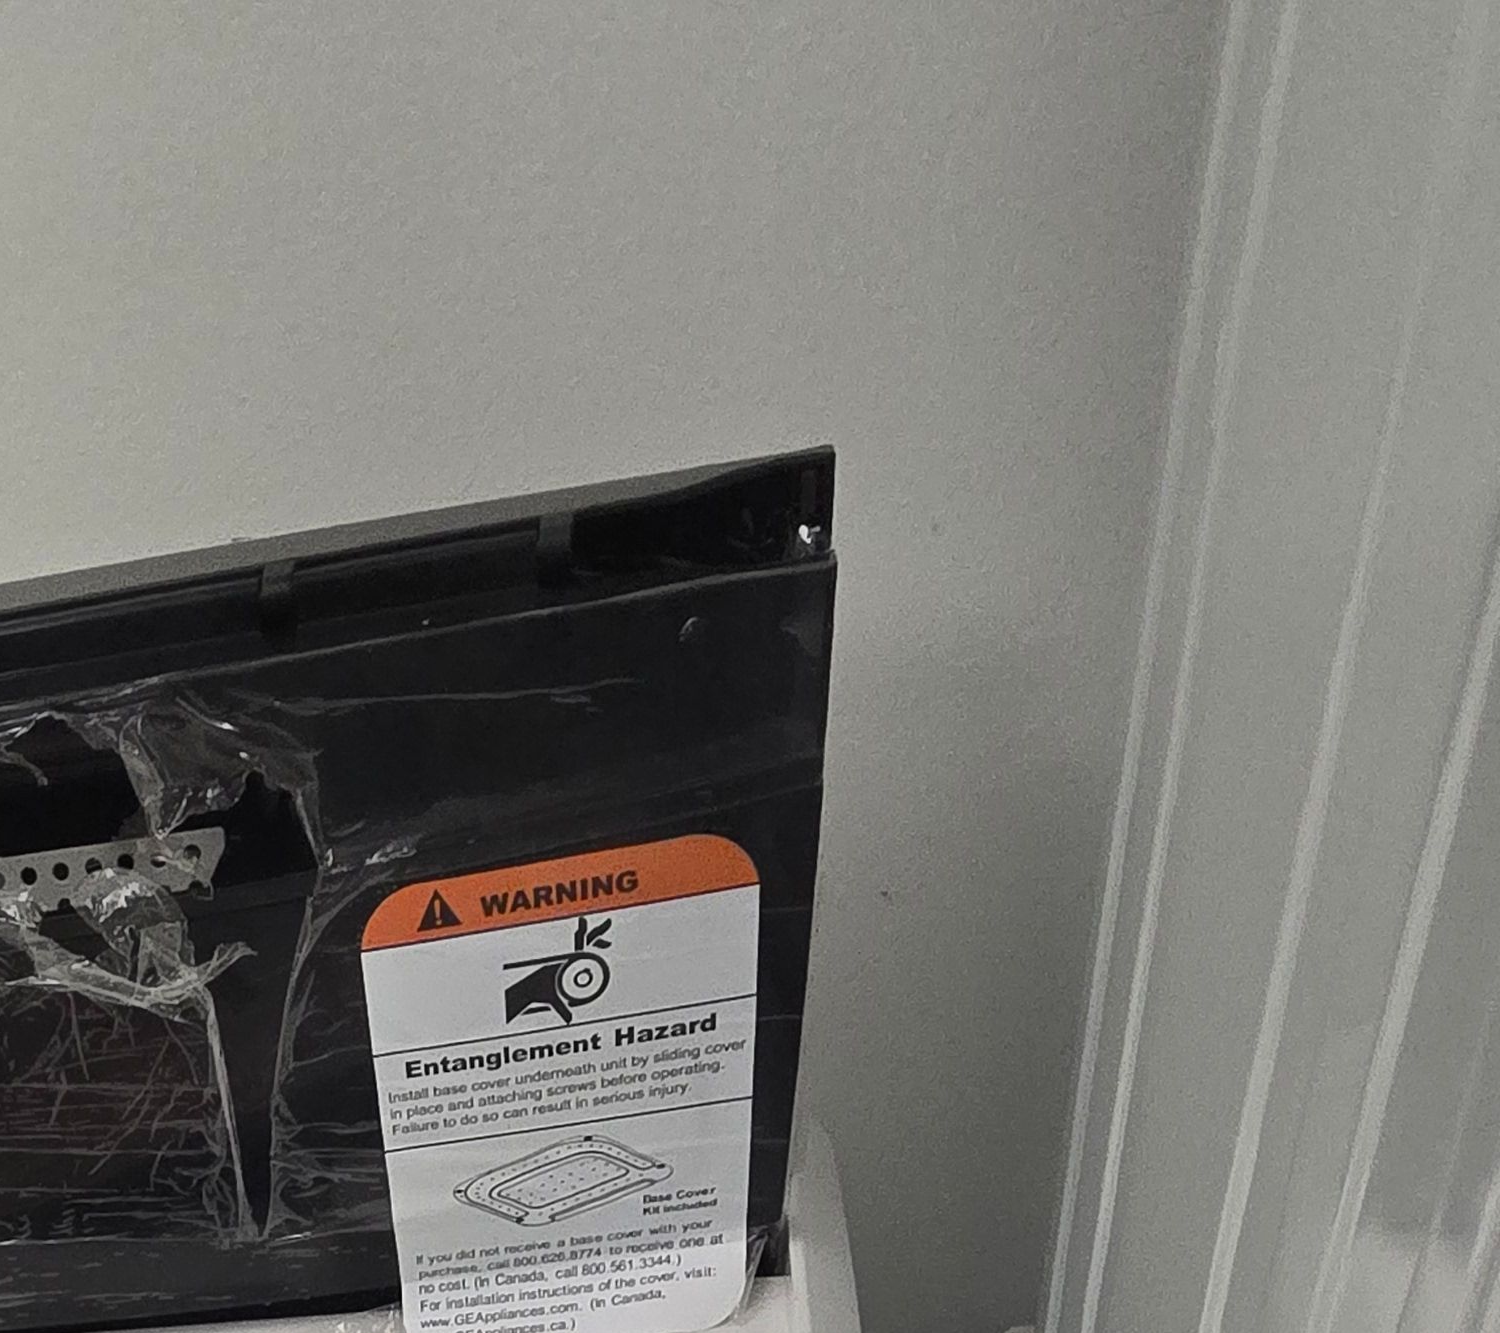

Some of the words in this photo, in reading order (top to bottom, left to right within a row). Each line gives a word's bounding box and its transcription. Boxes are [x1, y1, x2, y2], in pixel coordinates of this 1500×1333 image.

[479, 869, 639, 917] WARNING
[404, 1033, 601, 1079] Entanglement
[614, 1011, 717, 1047] Hazard
[387, 1086, 429, 1104] Install
[432, 1083, 468, 1097] base
[470, 1076, 511, 1092] cover
[514, 1061, 597, 1085] underneath
[599, 1056, 627, 1072] unit
[630, 1055, 649, 1069] by
[652, 1046, 701, 1064] sliding
[703, 1038, 747, 1055] cover
[388, 1107, 403, 1120] in
[405, 1102, 444, 1120] place
[446, 1095, 474, 1112] and
[477, 1088, 542, 1107] attaching
[545, 1079, 597, 1097] screws
[599, 1072, 647, 1089] before
[649, 1060, 725, 1081] operating.
[391, 1120, 440, 1136] Failure
[441, 1117, 457, 1128] to
[459, 1113, 479, 1126] do
[481, 1111, 499, 1123] so
[501, 1106, 528, 1119] can
[531, 1098, 572, 1115] result
[574, 1095, 589, 1110] in
[591, 1088, 645, 1107] serious
[641, 1192, 673, 1205] Base
[675, 1186, 716, 1200] Cover
[641, 1205, 660, 1215] Kit
[426, 1252, 453, 1267] you
[454, 1247, 476, 1261] did
[478, 1245, 500, 1258] not
[503, 1240, 551, 1254] receive
[556, 1239, 566, 1248] a
[568, 1234, 603, 1247] base
[606, 1228, 643, 1242] cover
[681, 1218, 713, 1234] your
[608, 1245, 623, 1255] to
[624, 1239, 674, 1253] receive
[678, 1236, 705, 1249] one
[709, 1232, 723, 1245] at
[417, 1282, 436, 1295] no
[493, 1269, 548, 1286] Canada,
[554, 1264, 578, 1280] call
[419, 1298, 441, 1313] For
[444, 1291, 515, 1310] installation
[517, 1282, 594, 1301] instructions
[597, 1277, 612, 1292] of
[613, 1277, 636, 1290] the
[683, 1266, 716, 1279] visit:
[610, 1288, 666, 1306] Canada,
